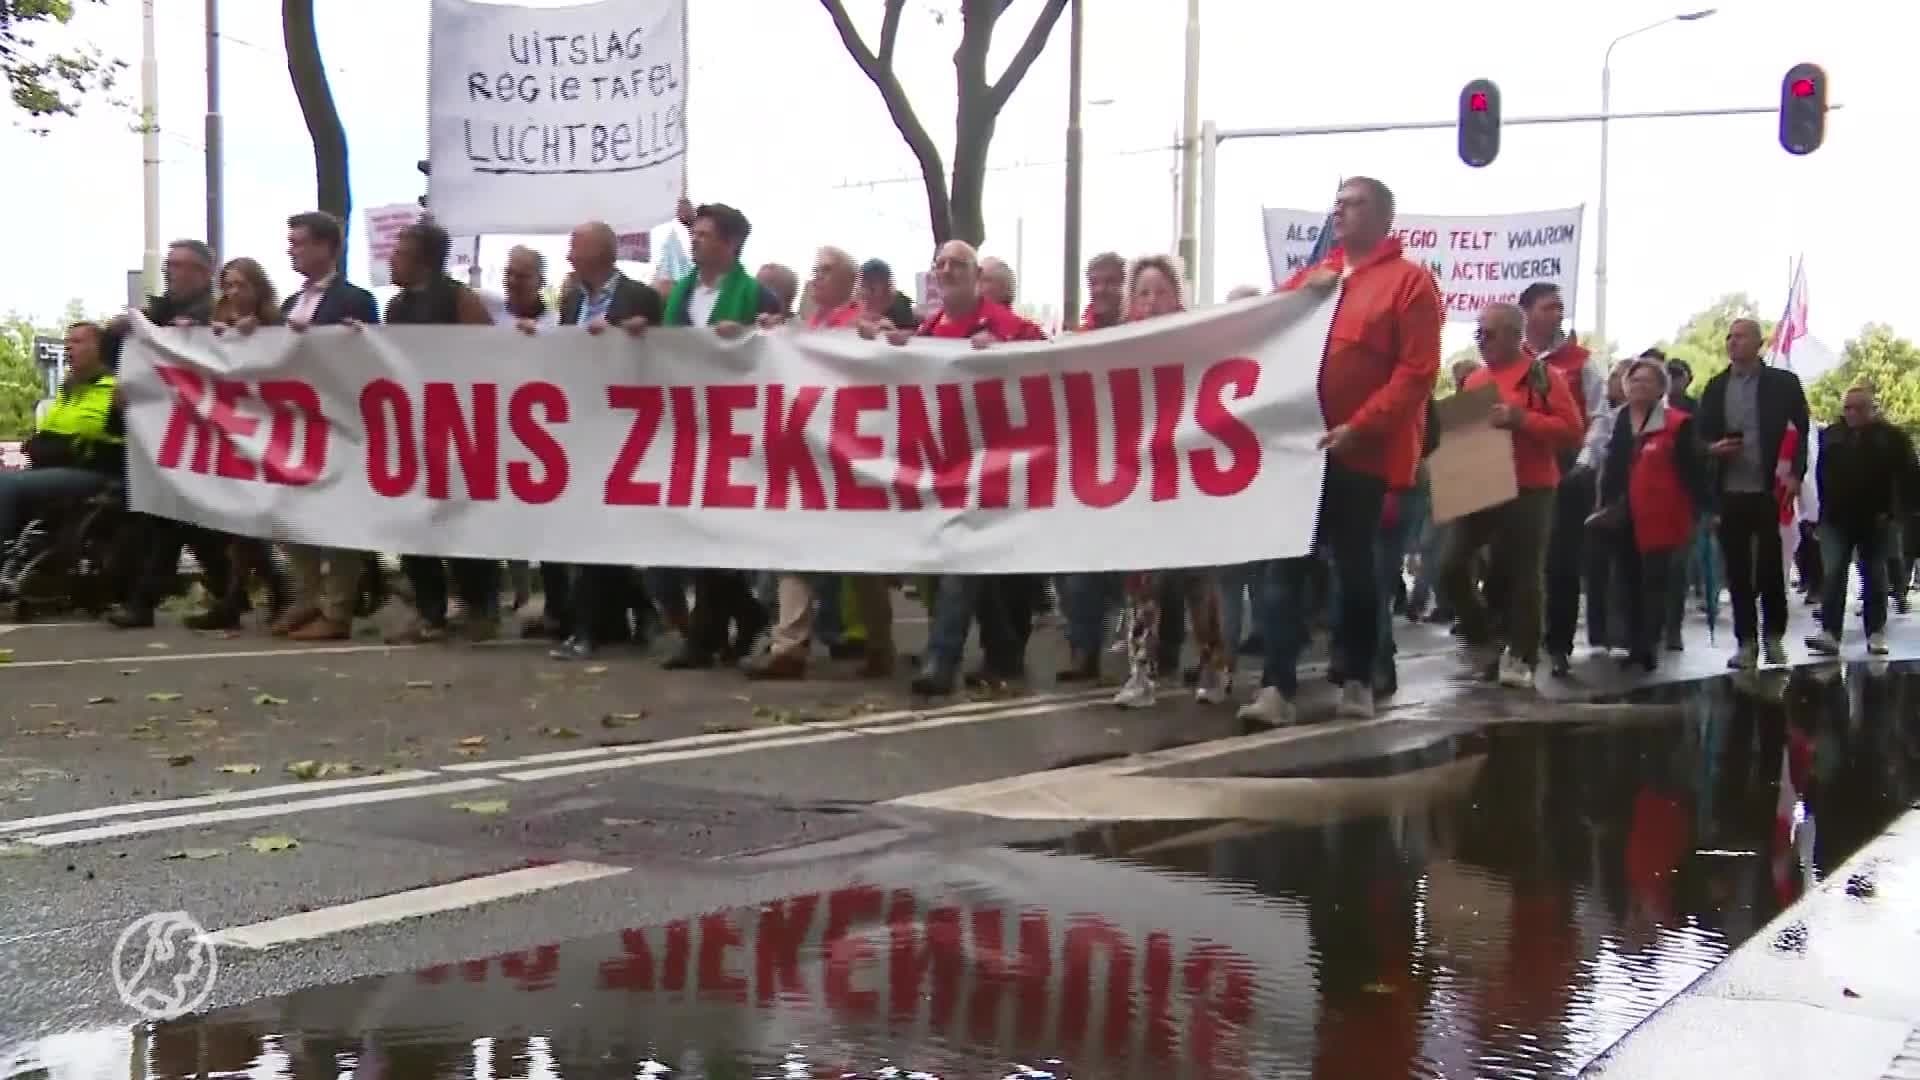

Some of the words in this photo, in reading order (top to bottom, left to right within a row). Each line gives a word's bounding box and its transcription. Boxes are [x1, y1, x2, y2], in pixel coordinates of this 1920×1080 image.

[1391, 229, 1438, 249] EGIO
[1507, 223, 1575, 249] WAAROM
[1451, 257, 1561, 281] ACTIEVOEREN
[1445, 290, 1517, 311] KENHUIS
[154, 362, 331, 486] RED
[359, 378, 571, 505] ONS
[603, 356, 1262, 511] ZIEKENHUIS
